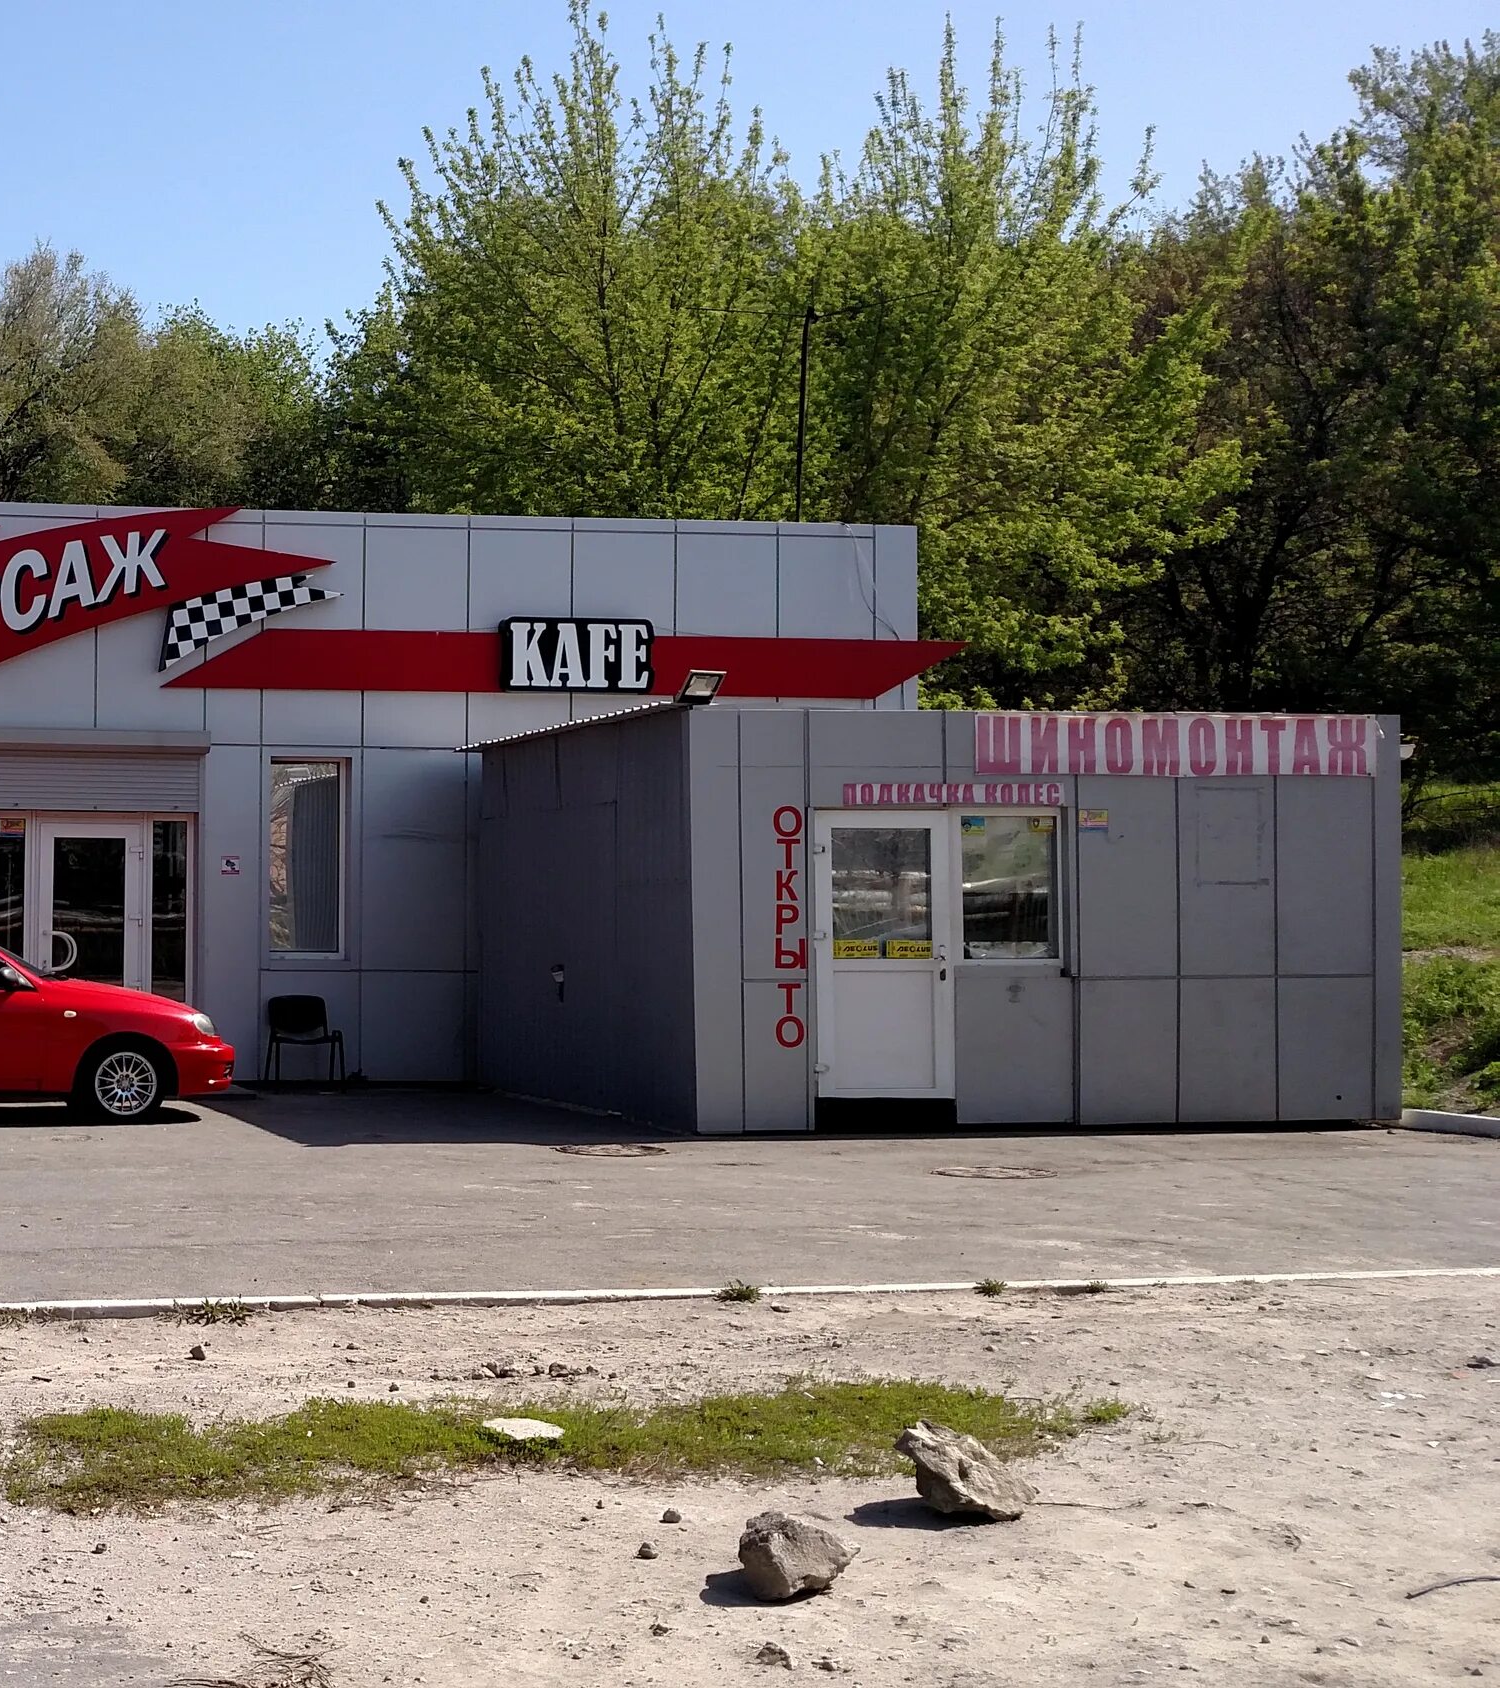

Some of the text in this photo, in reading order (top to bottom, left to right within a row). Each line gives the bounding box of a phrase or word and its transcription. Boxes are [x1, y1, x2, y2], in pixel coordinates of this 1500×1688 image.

[510, 622, 650, 689] KAFE
[976, 715, 1368, 777] ШИНОМОНТАЖ
[843, 784, 974, 806] ПОДКАЧКА
[773, 805, 809, 1048] ОТКРЫТО
[896, 945, 931, 953] AEOLUS
